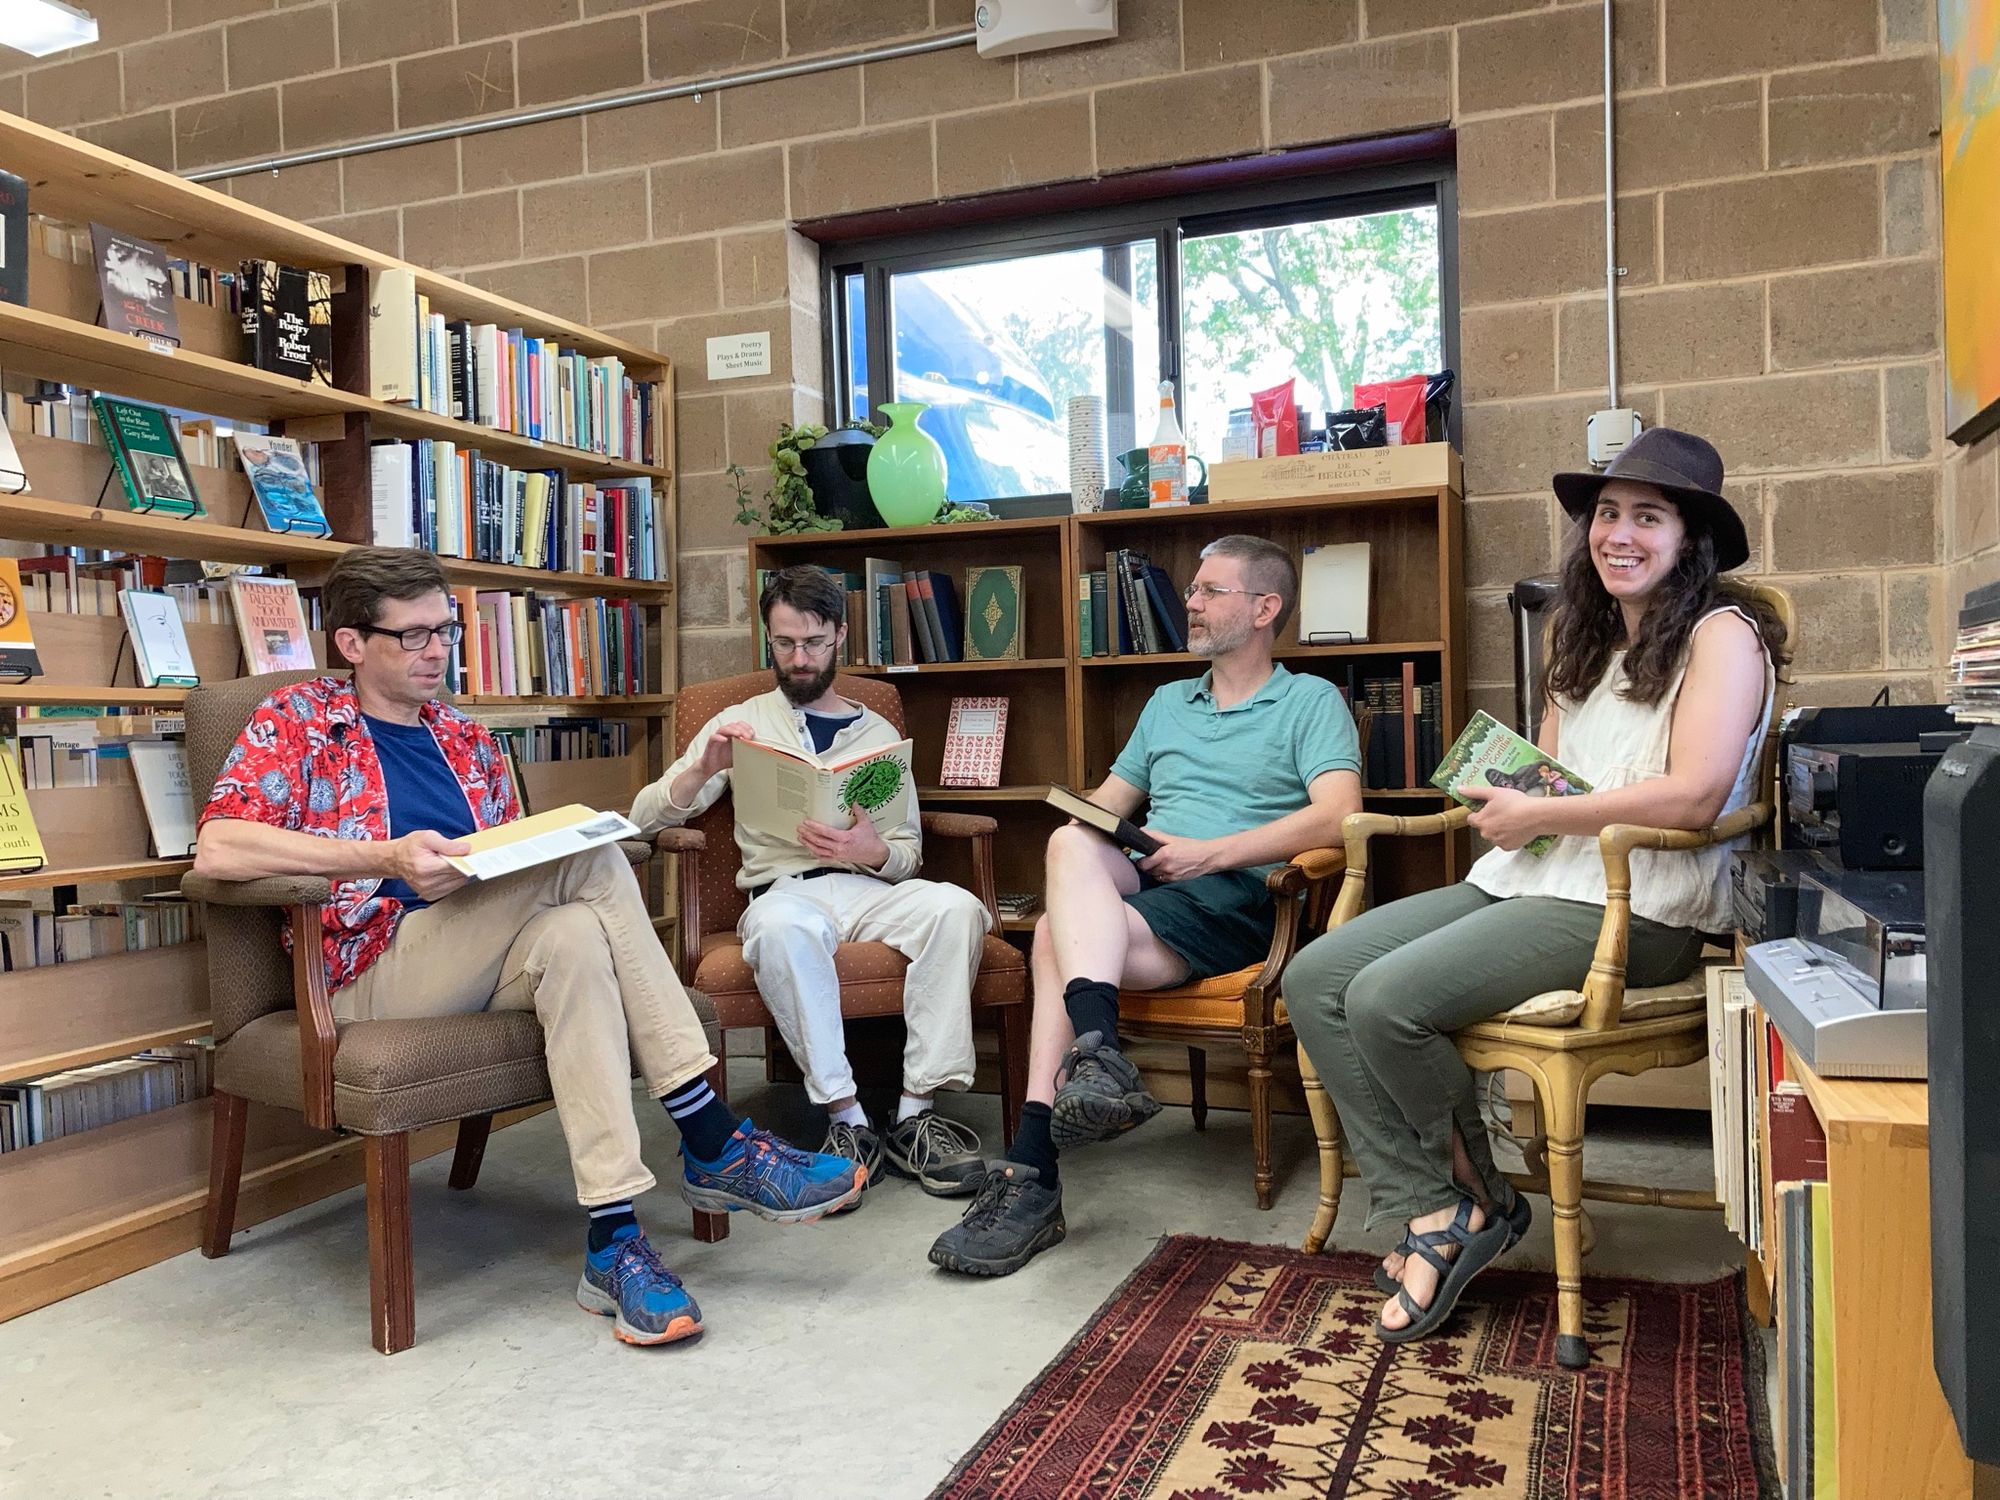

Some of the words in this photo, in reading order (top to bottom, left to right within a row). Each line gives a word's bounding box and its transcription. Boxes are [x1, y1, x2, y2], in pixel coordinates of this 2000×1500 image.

[284, 312, 304, 325] The
[278, 319, 309, 336] Poetry
[289, 330, 300, 341] of
[278, 337, 311, 353] Robert
[283, 347, 307, 360] Frost
[726, 361, 742, 369] Sheet
[129, 409, 142, 418] Out
[135, 418, 150, 427] Rain
[124, 428, 140, 439] Gary
[141, 431, 160, 441] Snyder
[268, 440, 292, 450] Yonder
[1374, 449, 1390, 457] 2019
[1318, 469, 1371, 480] BERGUN
[274, 596, 289, 605] OF
[270, 618, 297, 628] WATER
[52, 741, 80, 749] Vintage
[1488, 736, 1512, 765] Gorillas
[873, 754, 908, 774] BALLADS
[1461, 765, 1480, 786] Good
[1476, 734, 1505, 766] Morning,
[838, 802, 847, 813] BY
[869, 782, 905, 813] GILBERT
[6, 822, 18, 832] in
[0, 836, 30, 849] outh
